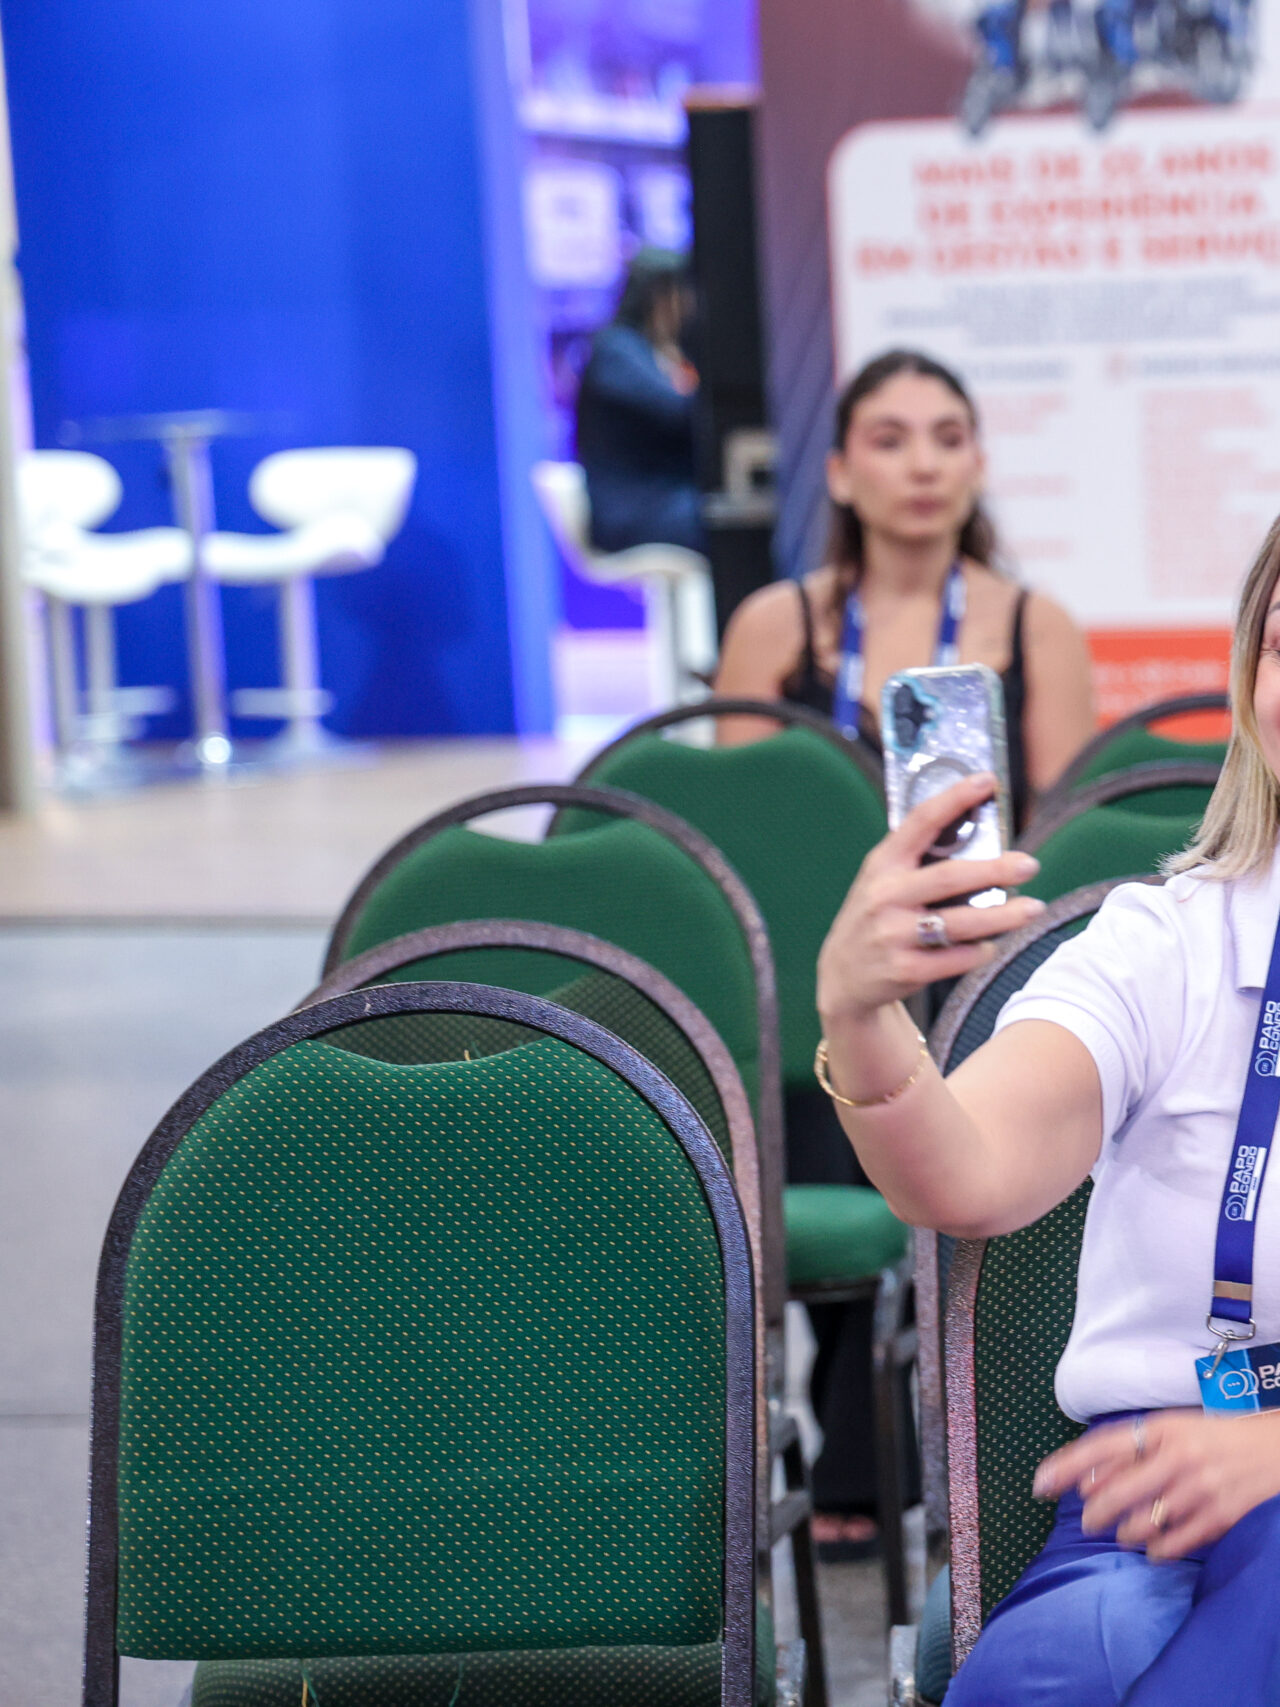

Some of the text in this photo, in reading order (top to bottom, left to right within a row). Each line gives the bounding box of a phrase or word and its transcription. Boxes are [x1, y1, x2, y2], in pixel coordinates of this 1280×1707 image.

[1259, 1000, 1278, 1050] PAPO
[1229, 1145, 1250, 1194] PAPO
[1240, 1146, 1258, 1194] CONDO
